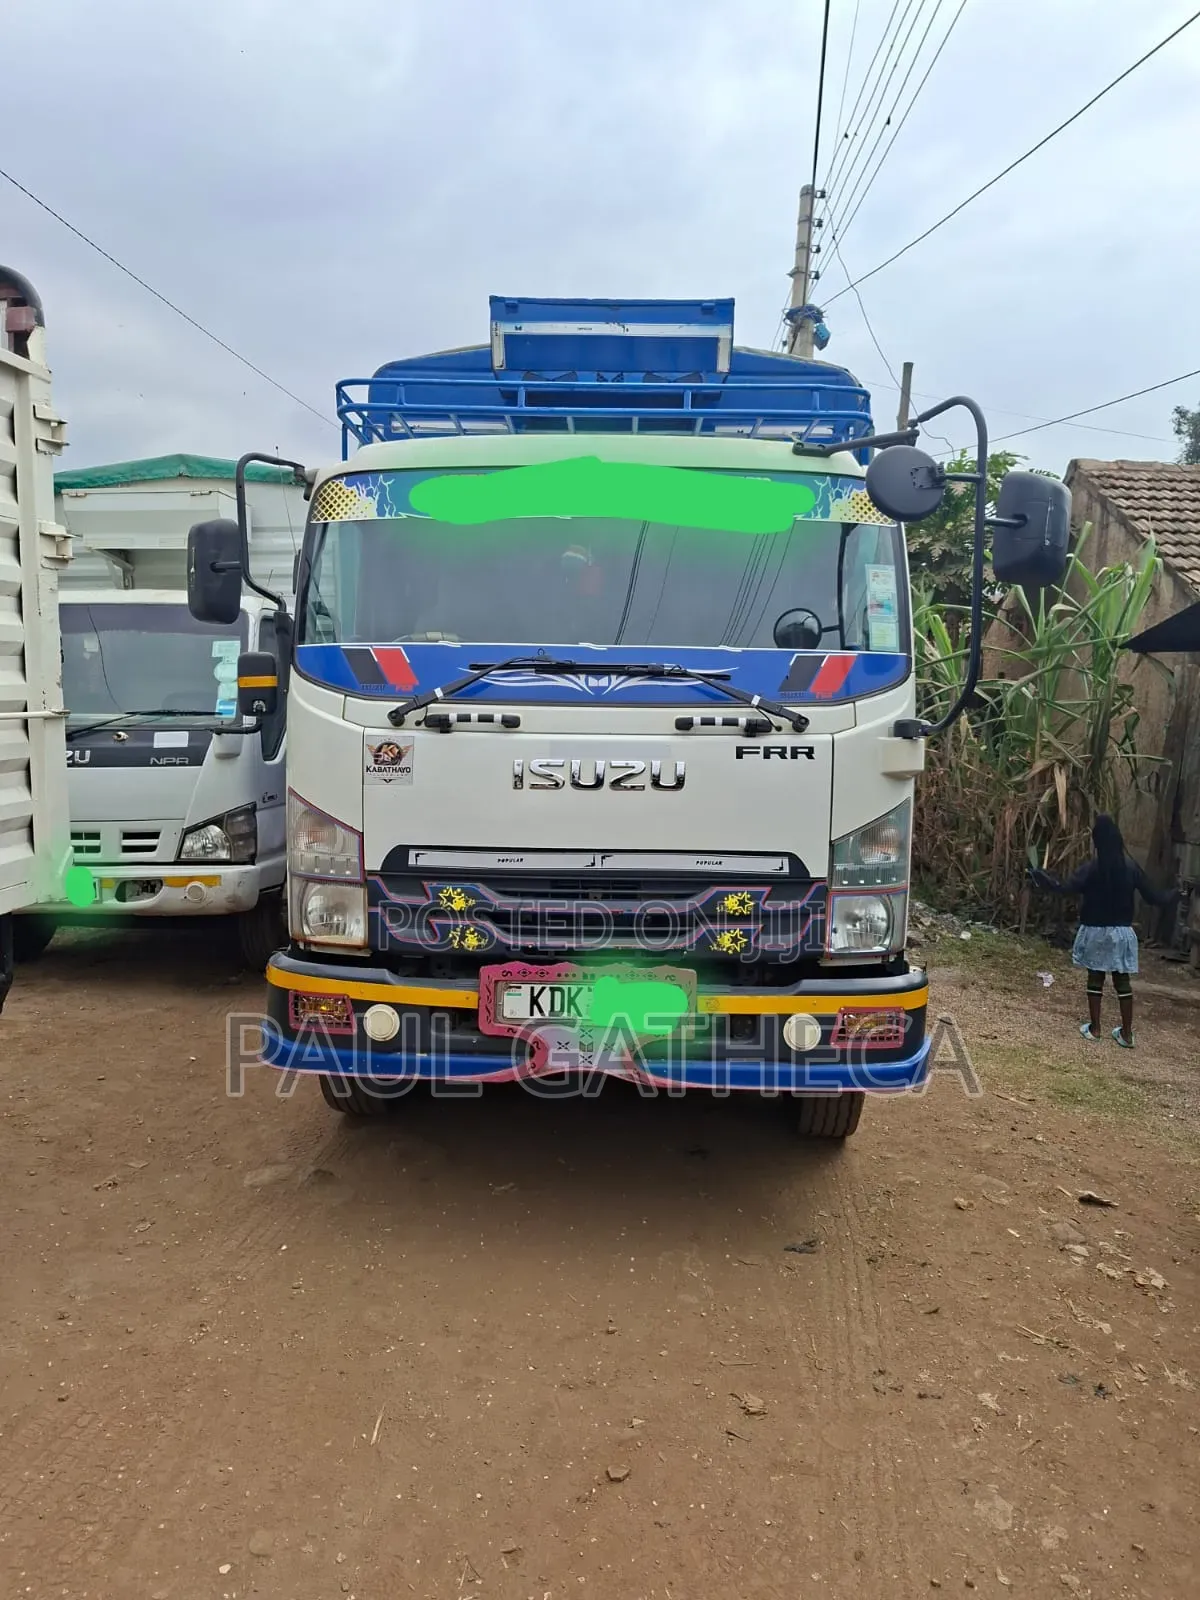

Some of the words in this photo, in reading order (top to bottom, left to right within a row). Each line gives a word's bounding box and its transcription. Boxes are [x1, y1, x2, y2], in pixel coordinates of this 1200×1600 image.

[150, 757, 189, 765] NPR
[736, 745, 815, 760] FRR
[513, 758, 686, 791] ISUZU
[529, 986, 583, 1017] KDK
